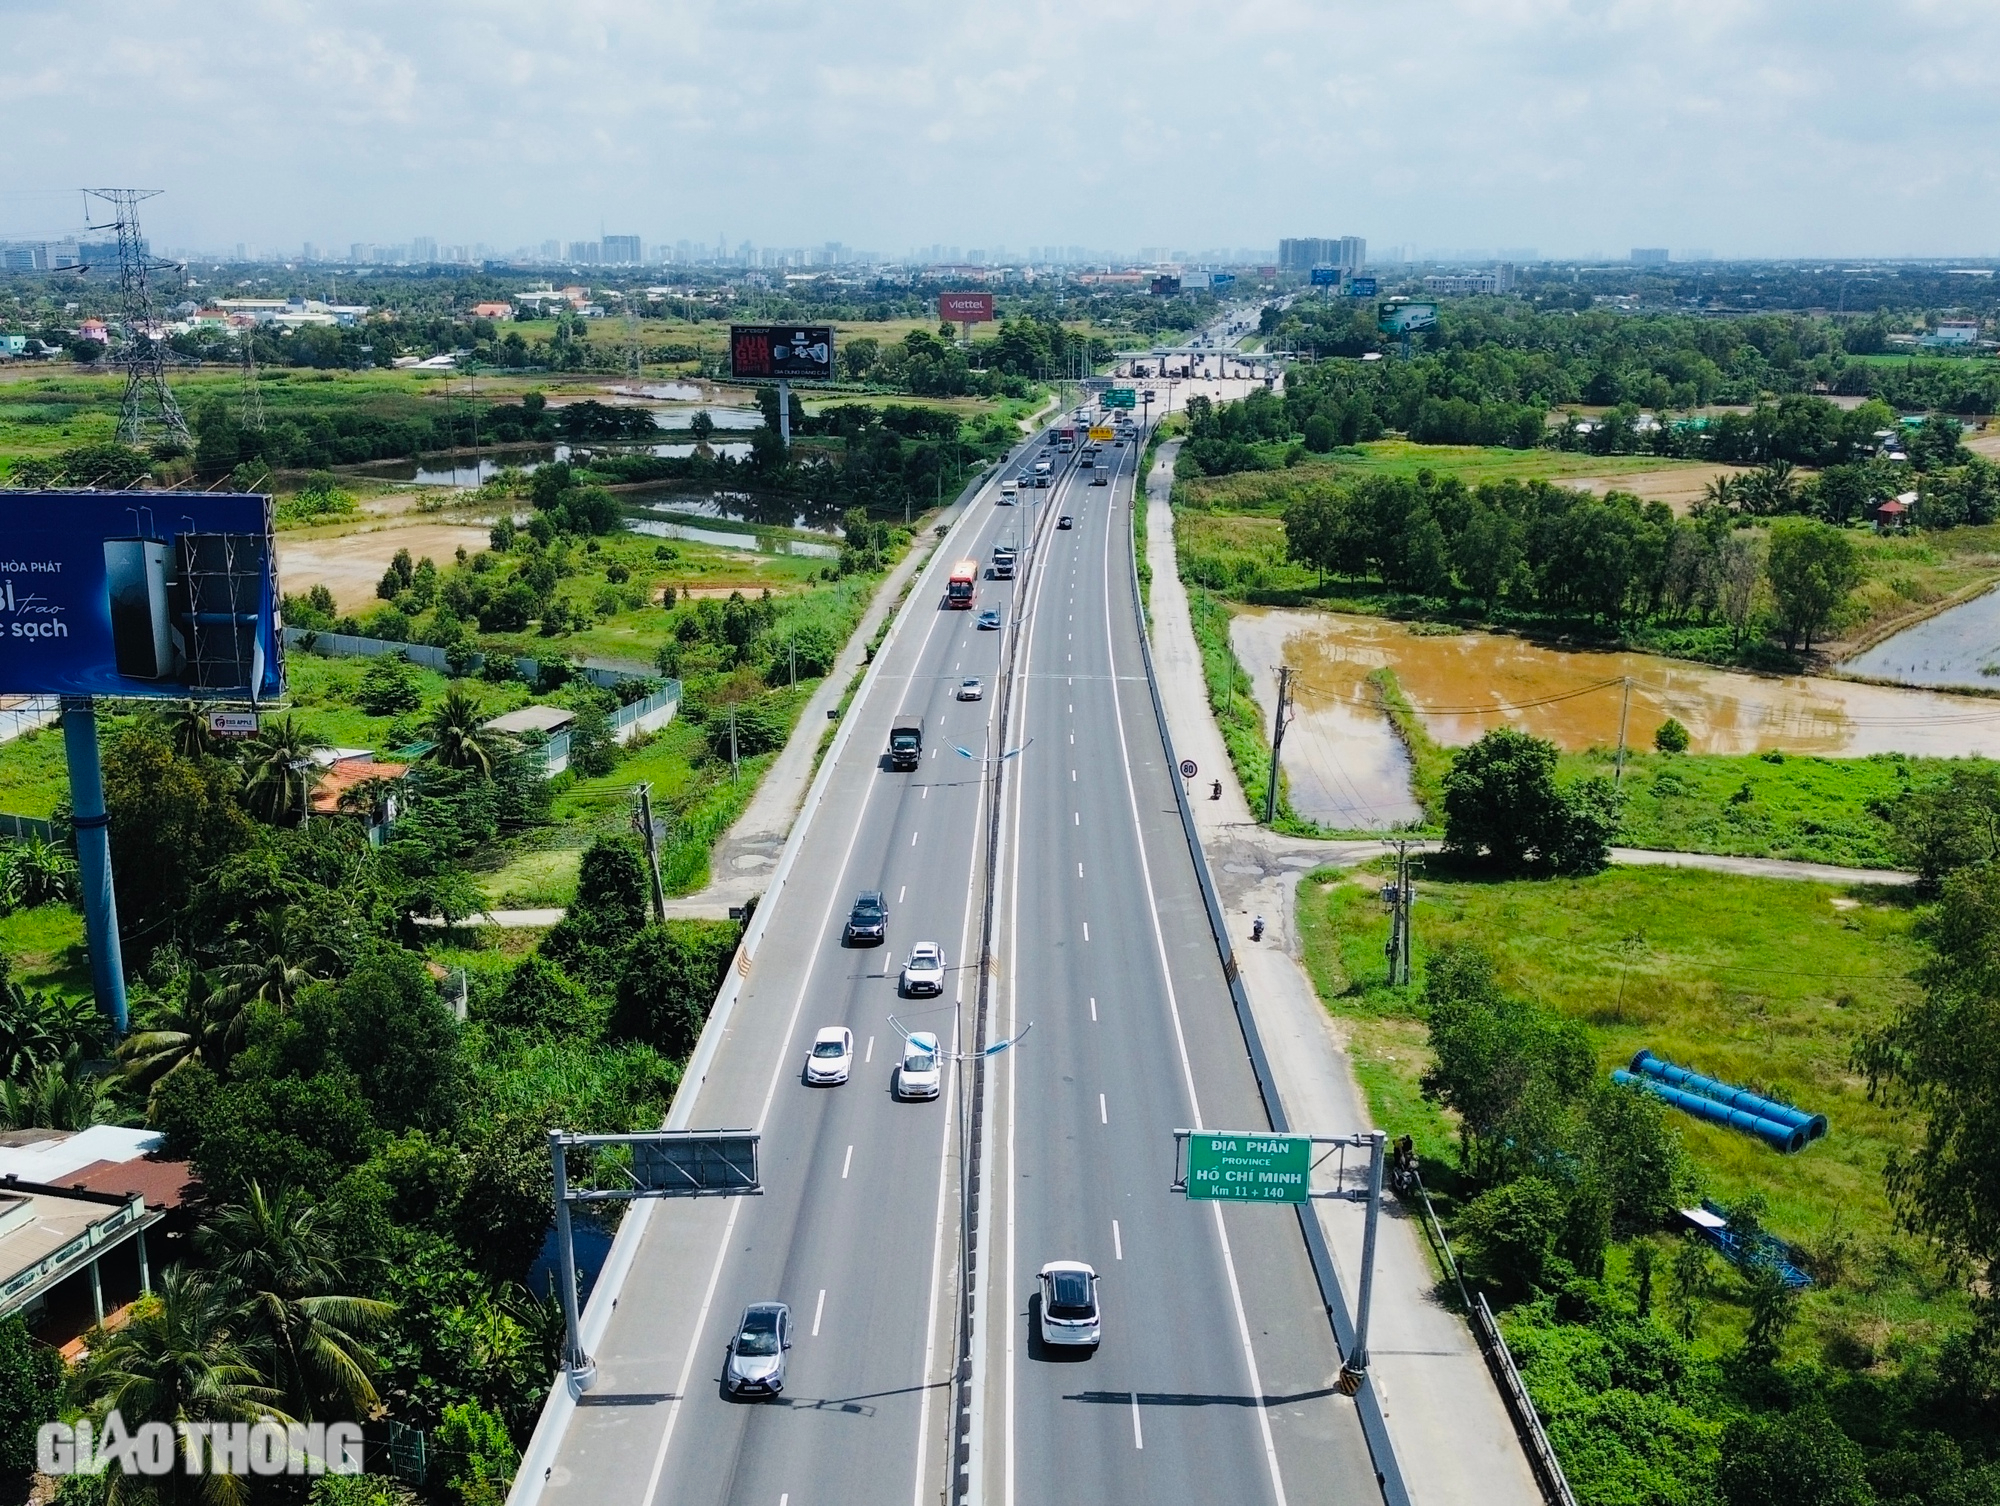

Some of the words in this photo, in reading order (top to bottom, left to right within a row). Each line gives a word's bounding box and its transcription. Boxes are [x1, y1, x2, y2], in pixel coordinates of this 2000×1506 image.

[949, 300, 984, 308] viettel
[1, 560, 28, 572] HÒA
[31, 560, 62, 573] PHÁT
[11, 618, 68, 642] sạch
[1184, 764, 1193, 773] 80
[1211, 1140, 1237, 1154] ĐỊA
[1246, 1139, 1289, 1156] PHẬN
[1222, 1157, 1271, 1166] PROVINCE
[1225, 1168, 1254, 1182] CHÍ
[1258, 1172, 1301, 1184] MINH
[1211, 1185, 1229, 1196] Km
[1235, 1186, 1248, 1196] 11
[1251, 1189, 1259, 1197] +
[1263, 1187, 1284, 1198] 140
